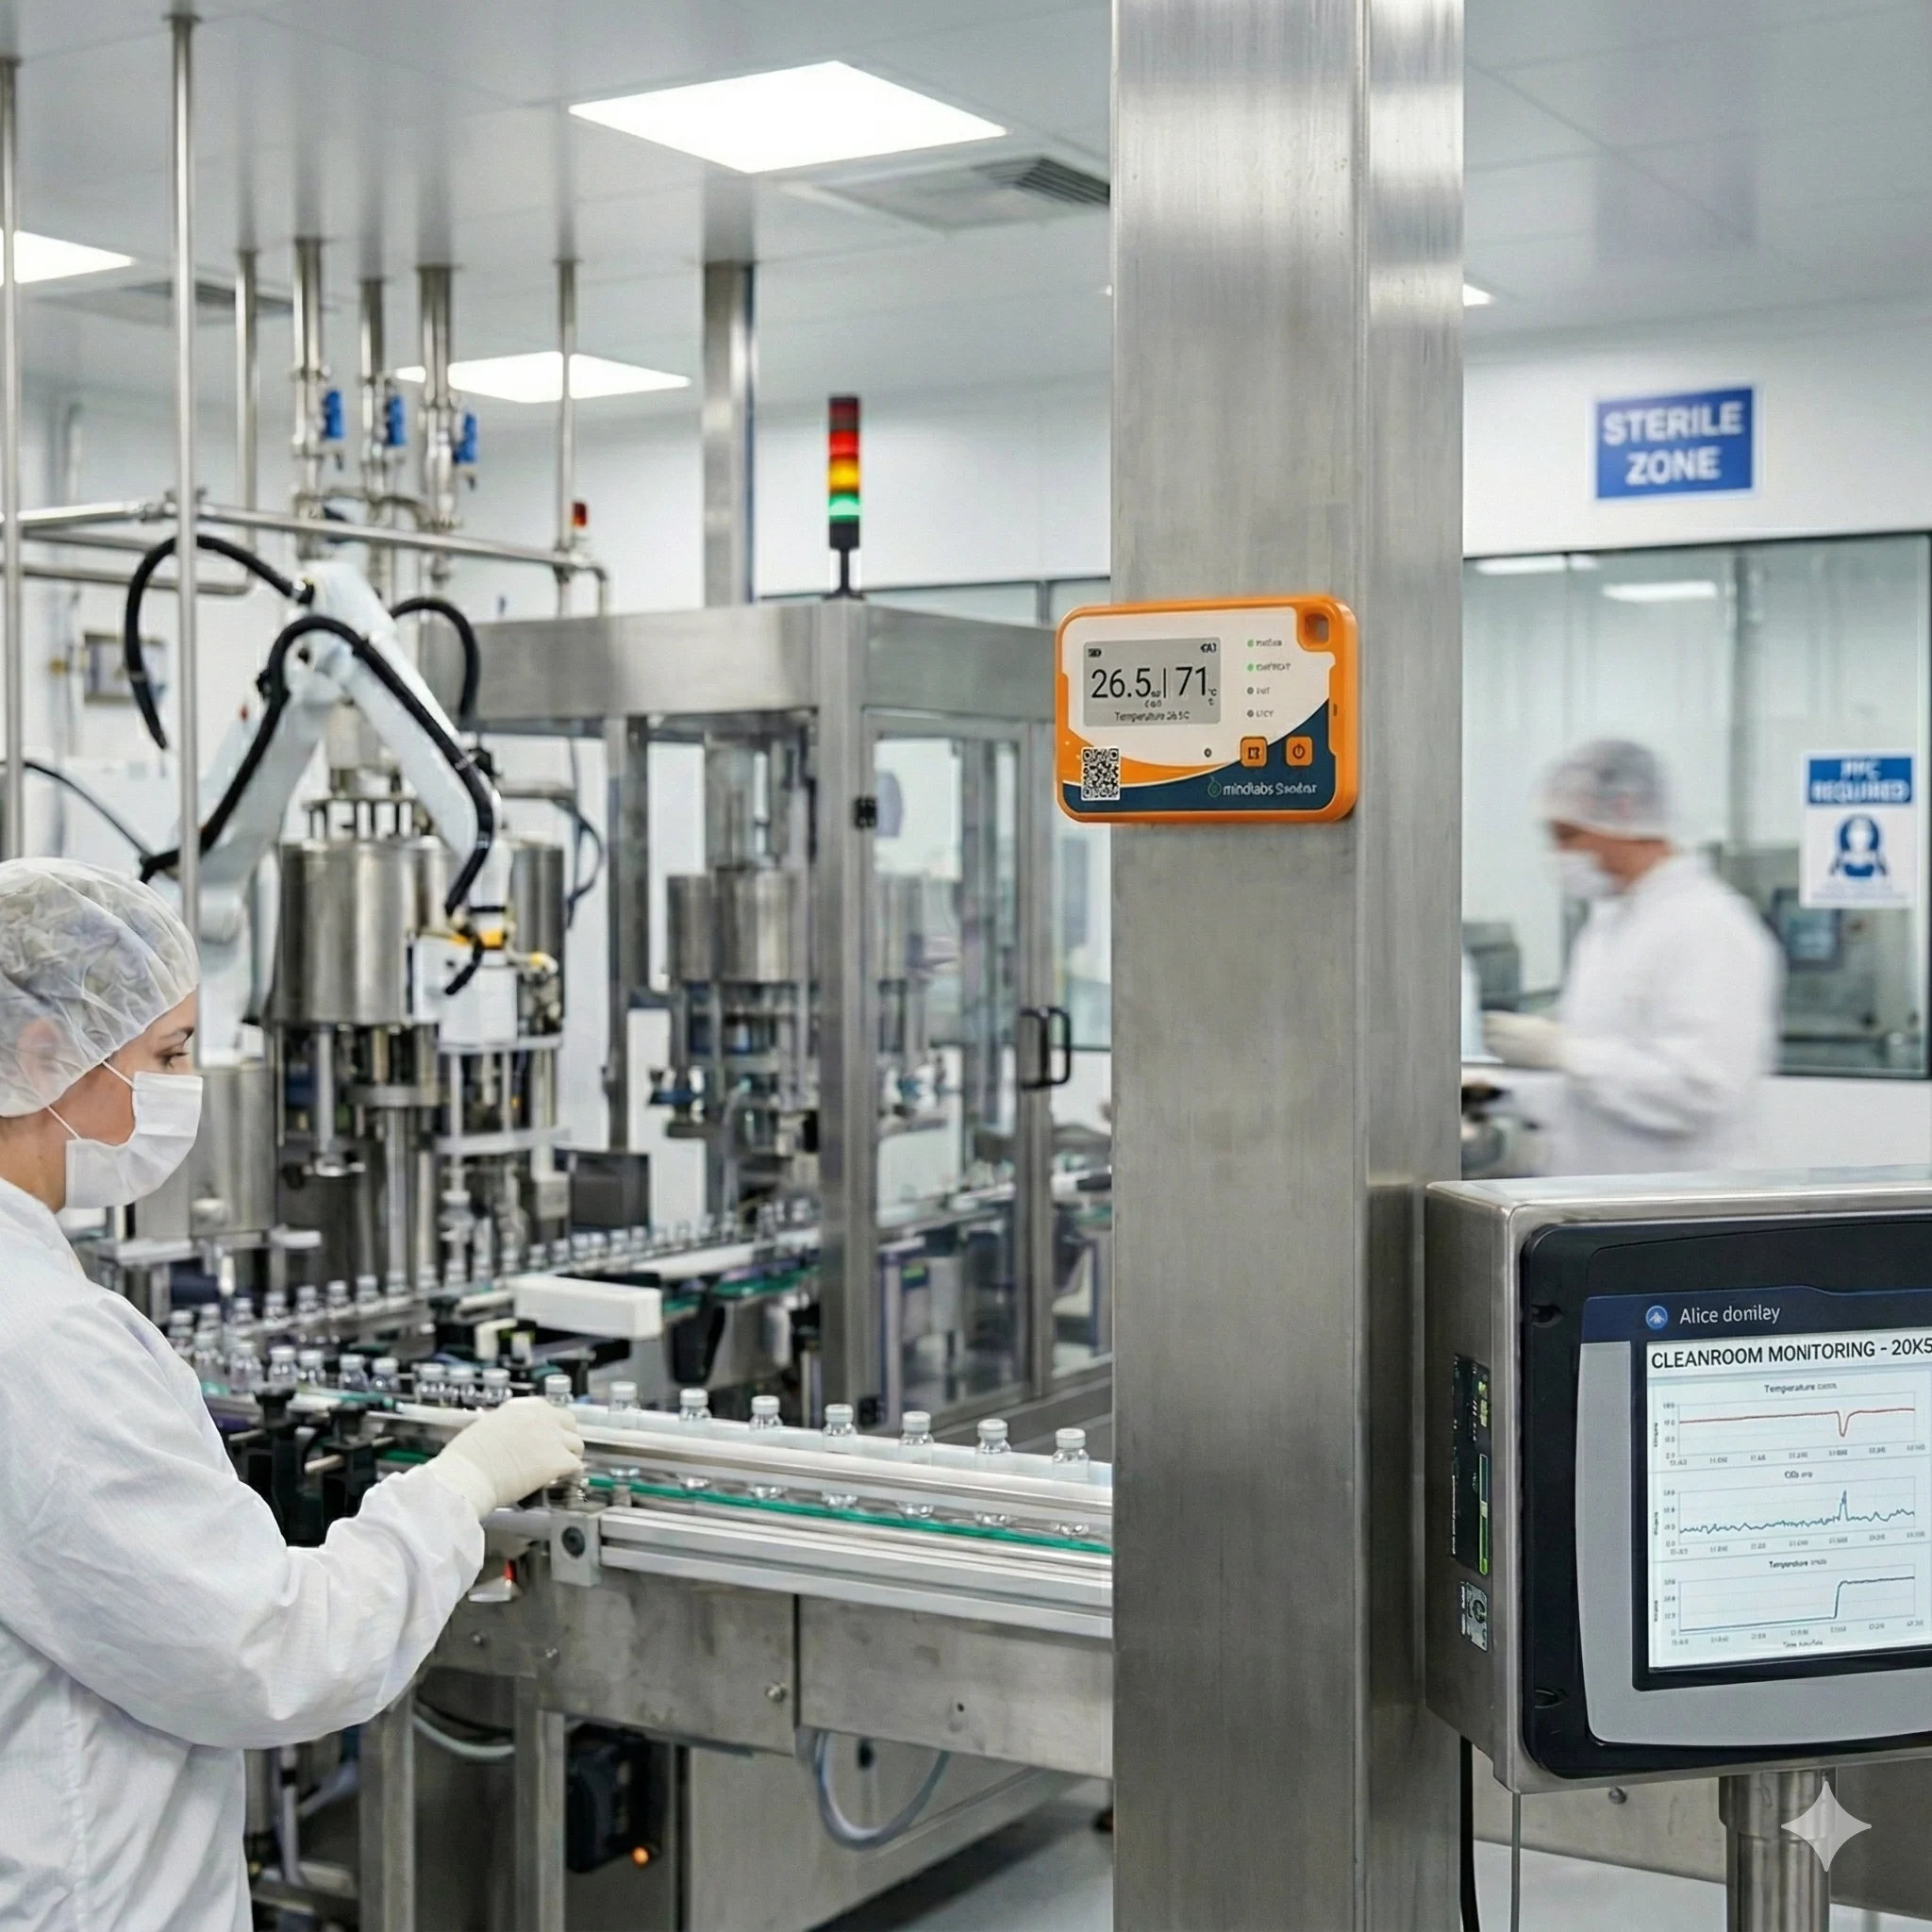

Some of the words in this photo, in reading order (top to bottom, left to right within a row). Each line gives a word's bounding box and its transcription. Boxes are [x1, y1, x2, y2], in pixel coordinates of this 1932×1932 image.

[1603, 400, 1744, 446] STERILE
[1624, 445, 1722, 486] ZONE
[1091, 668, 1151, 698] 26.5
[1175, 666, 1207, 696] 71
[1679, 1307, 1719, 1324] Alice
[1723, 1304, 1781, 1324] doniley
[1651, 1347, 1762, 1369] CLEANROOM
[1769, 1341, 1875, 1363] MONITORING
[1891, 1337, 1932, 1357] 20X5
